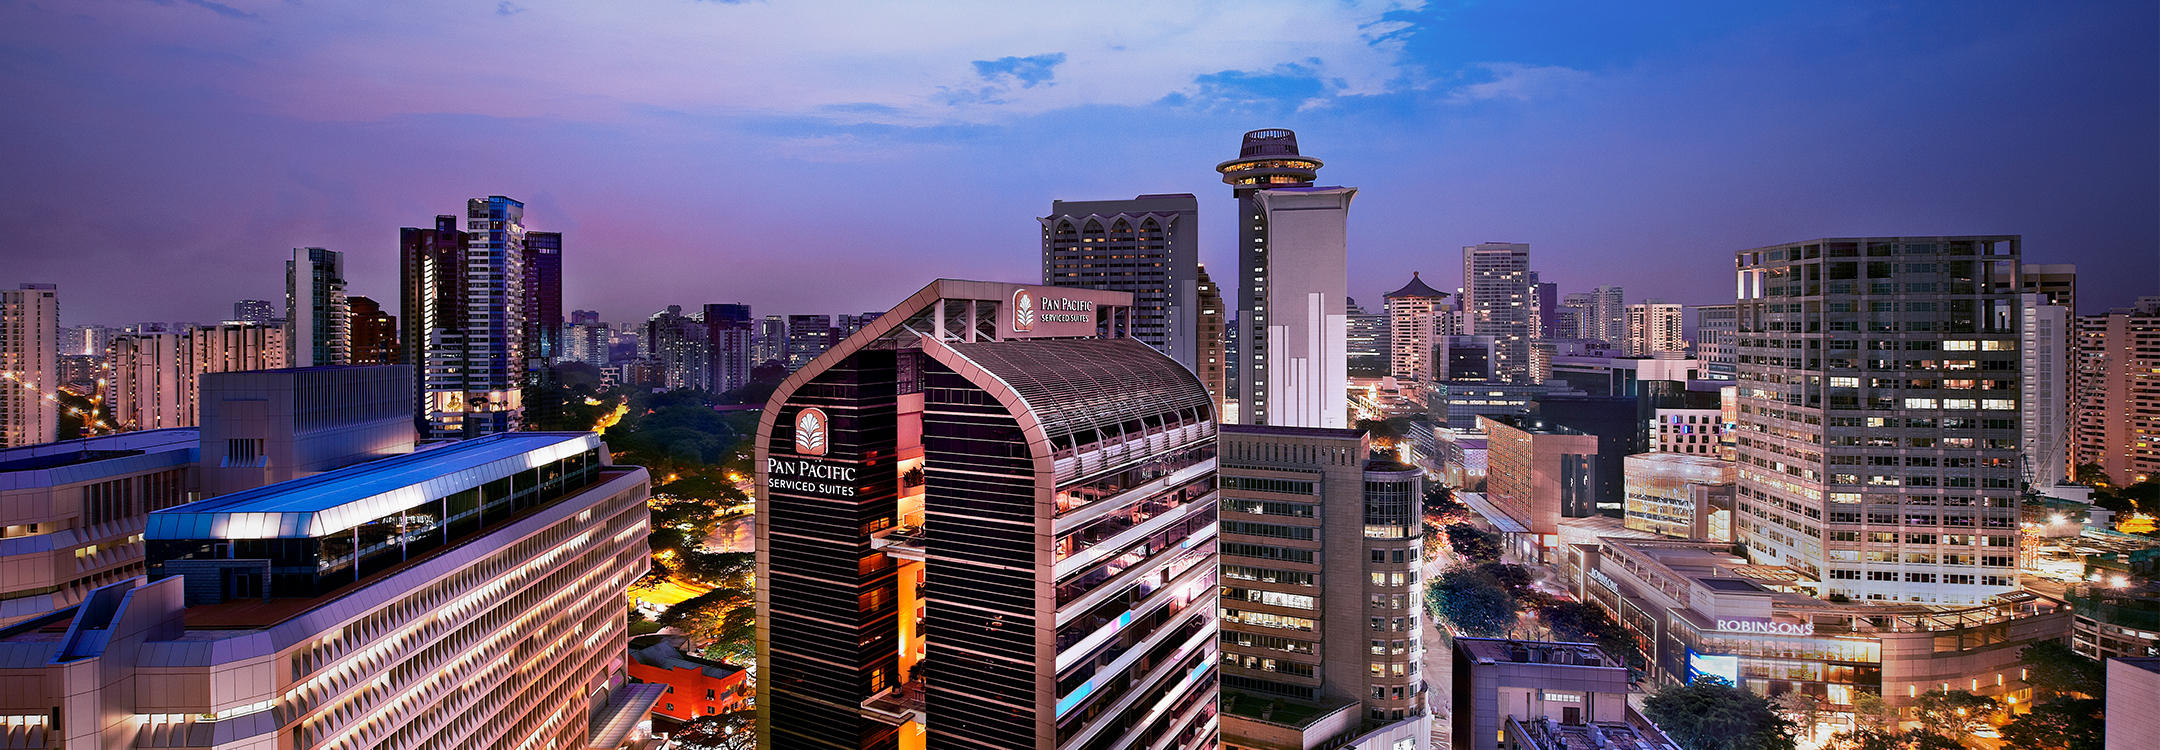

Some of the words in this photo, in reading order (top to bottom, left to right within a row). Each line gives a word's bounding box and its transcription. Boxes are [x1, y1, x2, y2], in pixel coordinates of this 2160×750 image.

[1041, 297, 1060, 310] PAN
[1062, 298, 1093, 312] PACIFIC
[1041, 314, 1070, 322] SERVICED
[1070, 314, 1089, 323] SUITES
[767, 458, 795, 475] PAN
[800, 461, 856, 482] PACIFIC
[768, 478, 816, 492] SERVICED
[819, 483, 855, 497] SUITES
[1717, 619, 1814, 636] ROBINSONS
